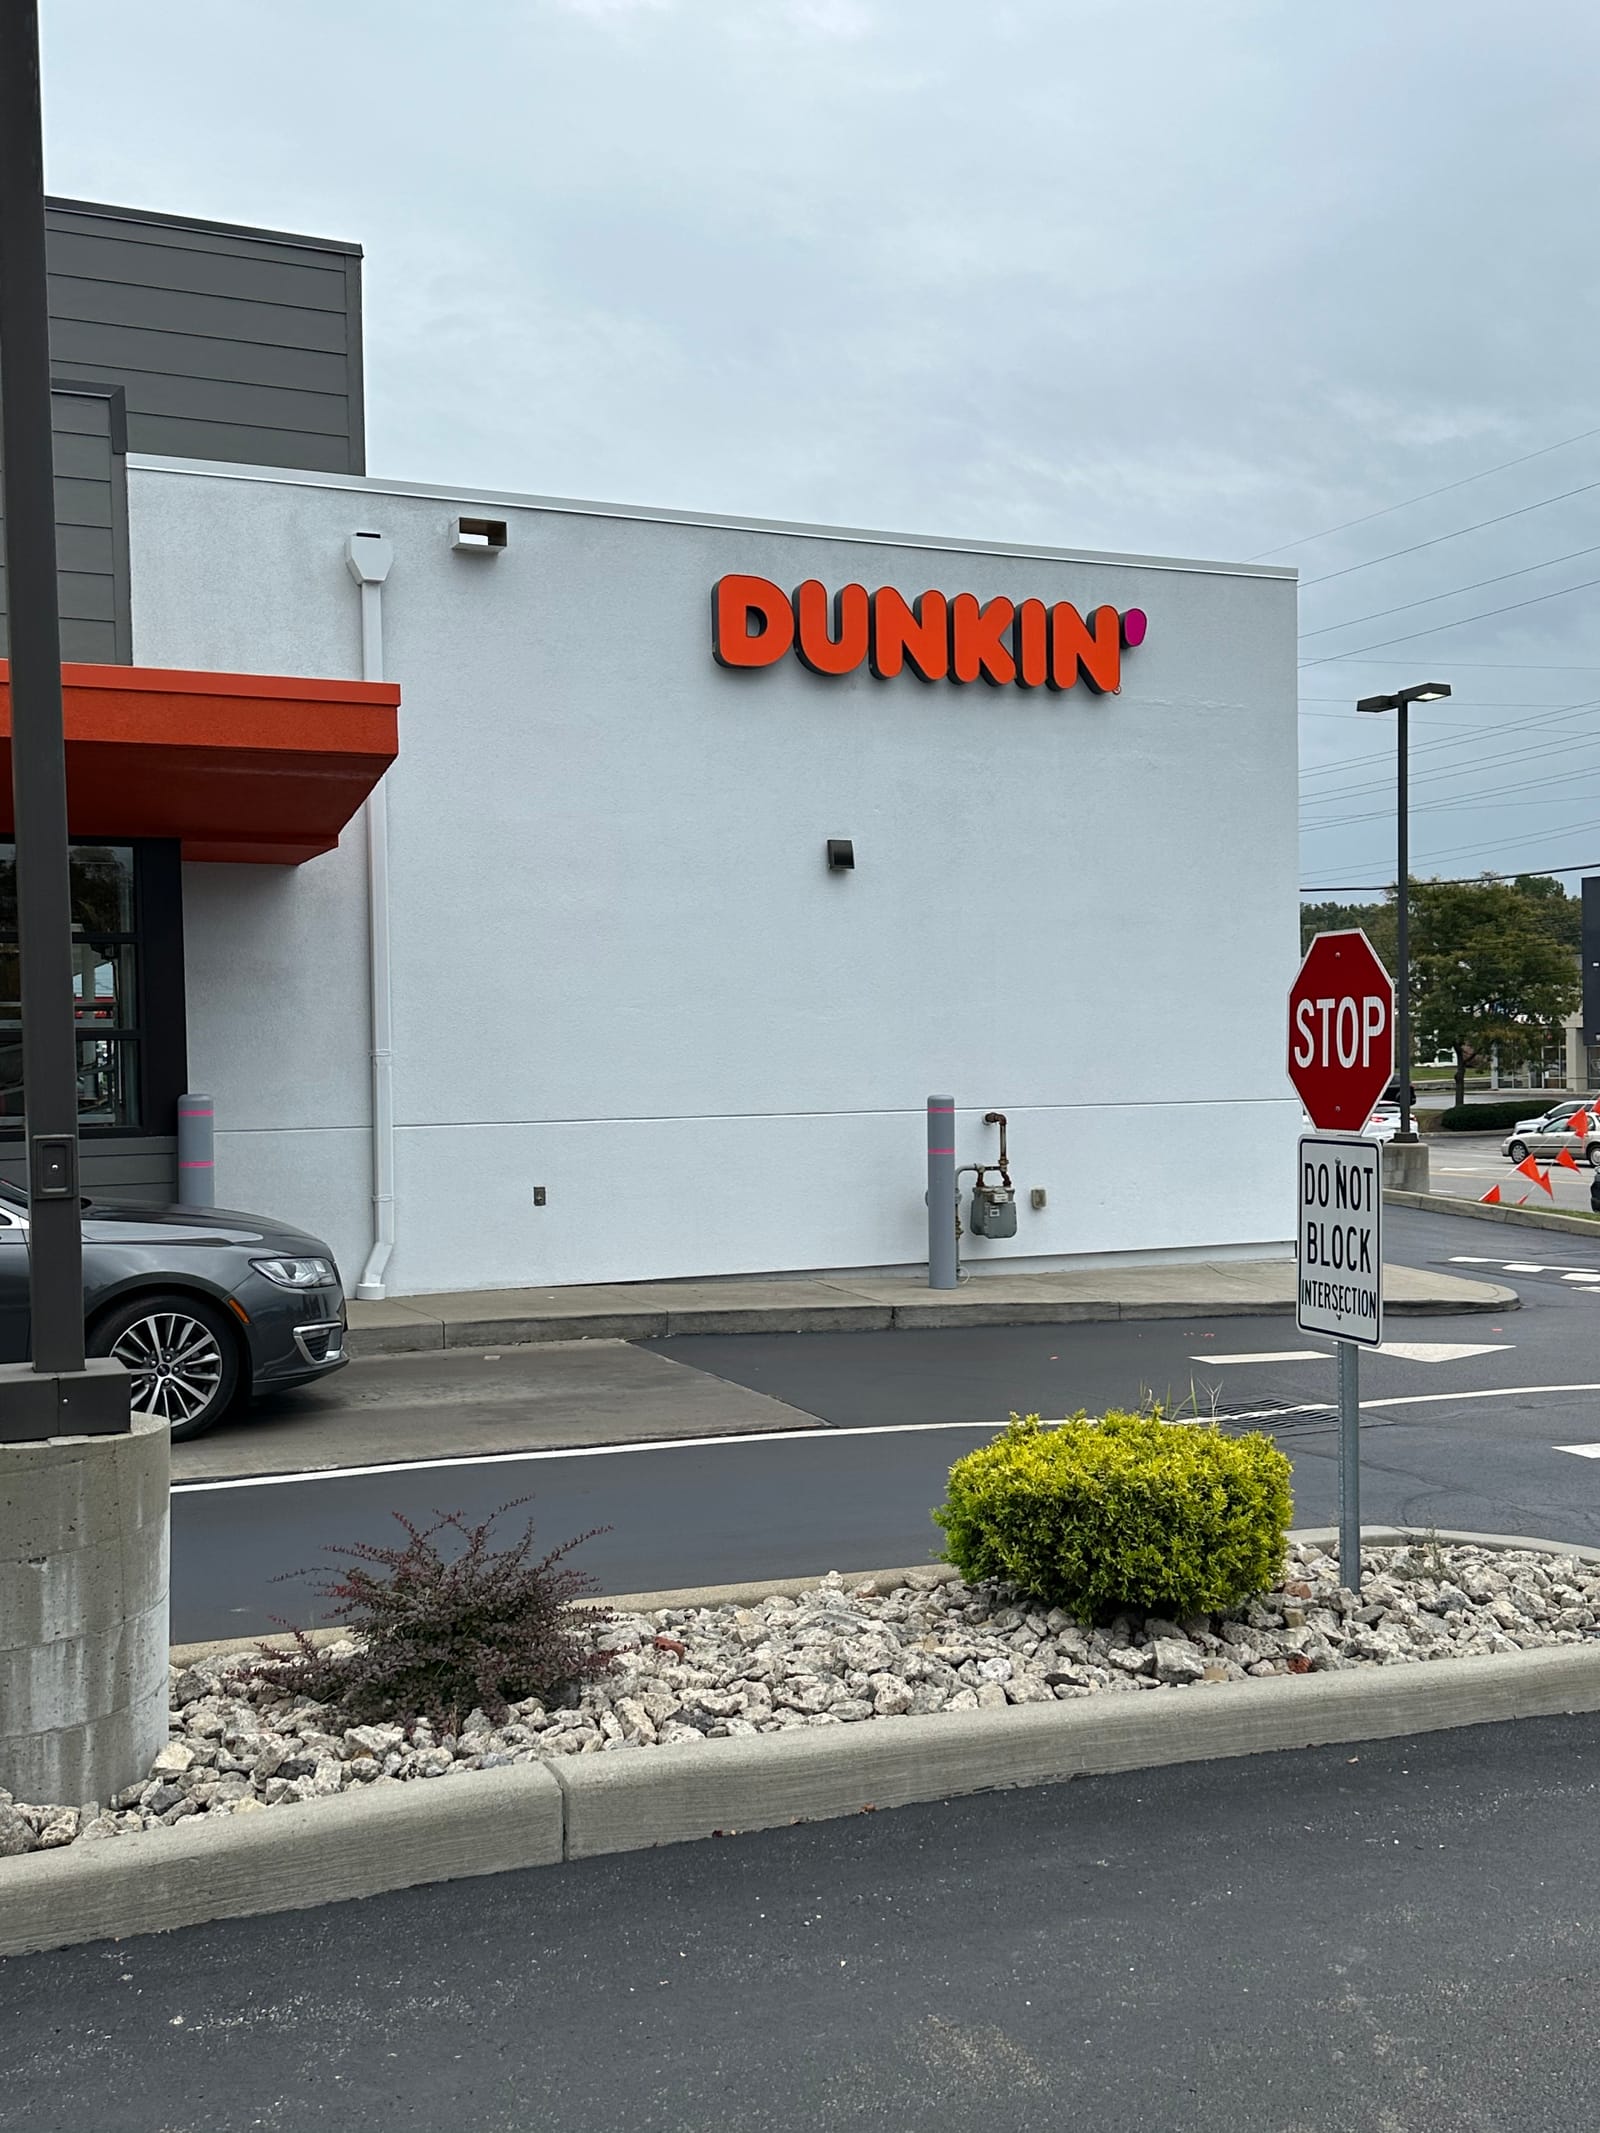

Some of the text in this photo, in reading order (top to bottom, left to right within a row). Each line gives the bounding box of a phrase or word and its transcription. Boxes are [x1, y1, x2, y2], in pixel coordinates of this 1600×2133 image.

[711, 573, 1148, 695] DUNKIN'
[1294, 996, 1386, 1069] STOP
[1304, 1162, 1374, 1212] DO NOT
[1307, 1220, 1372, 1274] BLOCK
[1301, 1278, 1377, 1320] INTERSECTION
